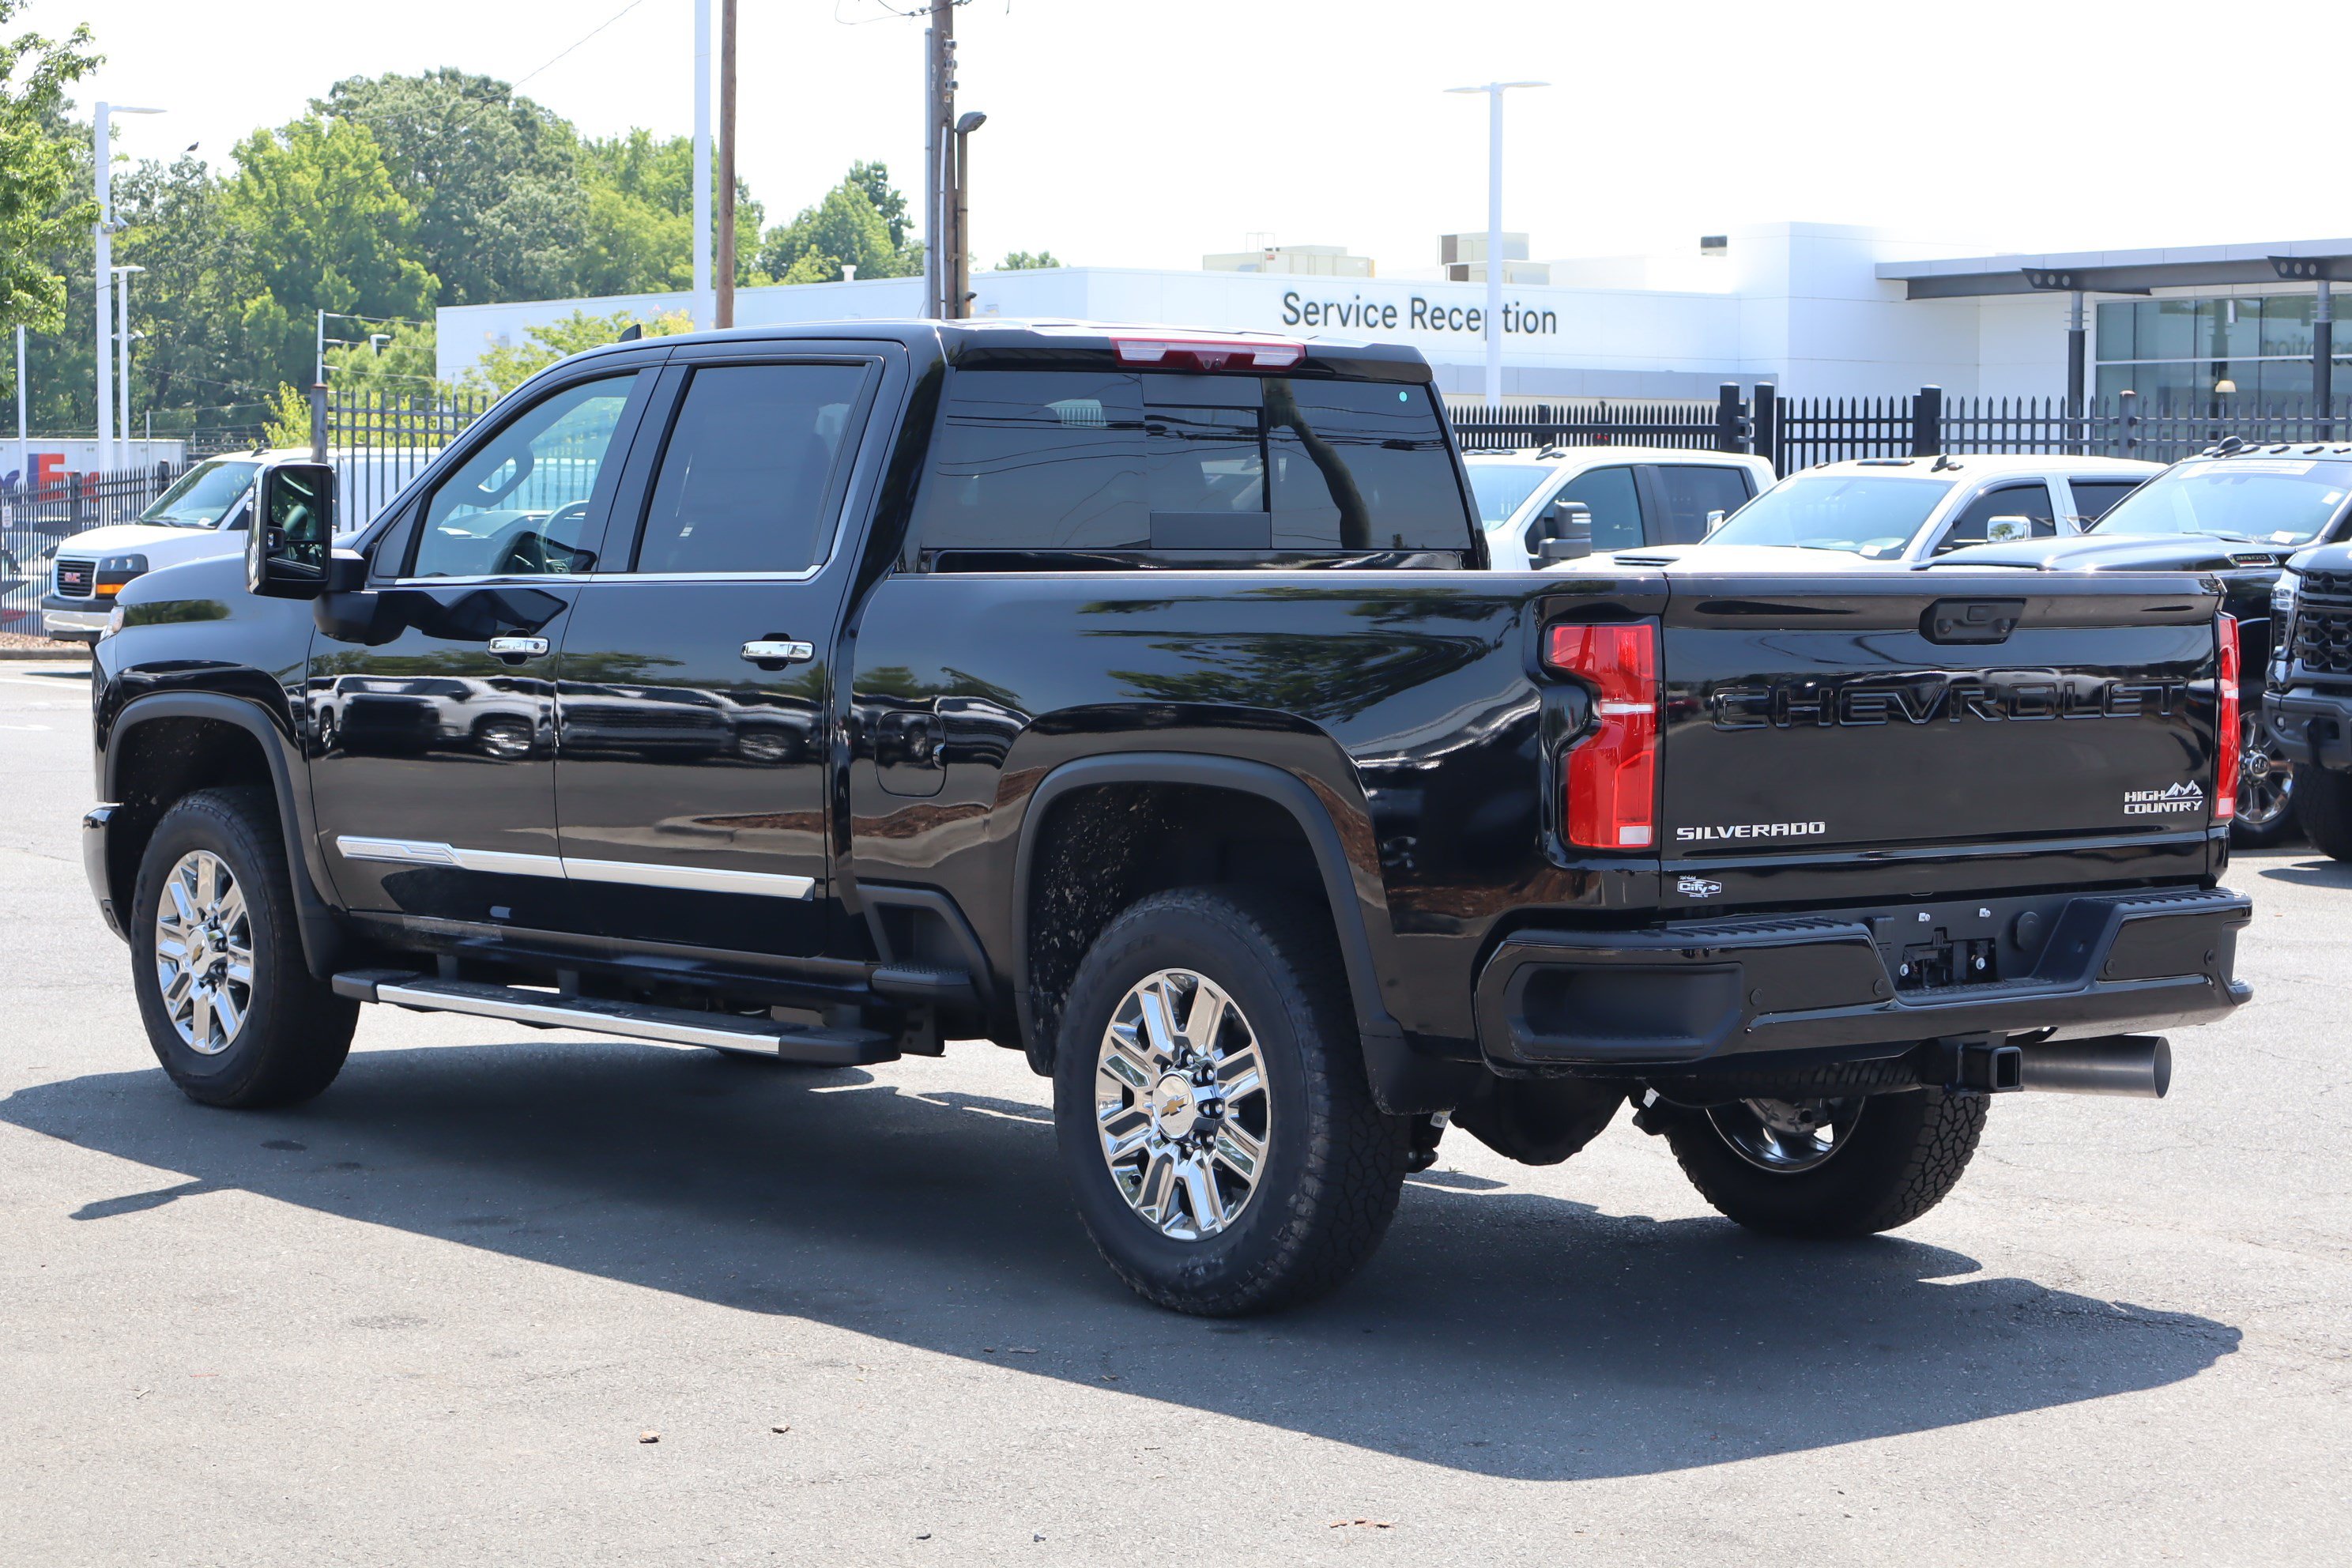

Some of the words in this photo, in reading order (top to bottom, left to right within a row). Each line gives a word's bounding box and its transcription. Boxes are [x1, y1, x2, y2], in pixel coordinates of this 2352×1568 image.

[1282, 292, 1397, 329] Service
[1411, 297, 1557, 341] Recetion
[1712, 677, 2188, 730] CHEVROLET
[2124, 790, 2165, 802] HIGH
[2124, 801, 2203, 815] COUNTRY
[1676, 821, 1826, 841] SILVERADO
[1679, 880, 1708, 894] City
